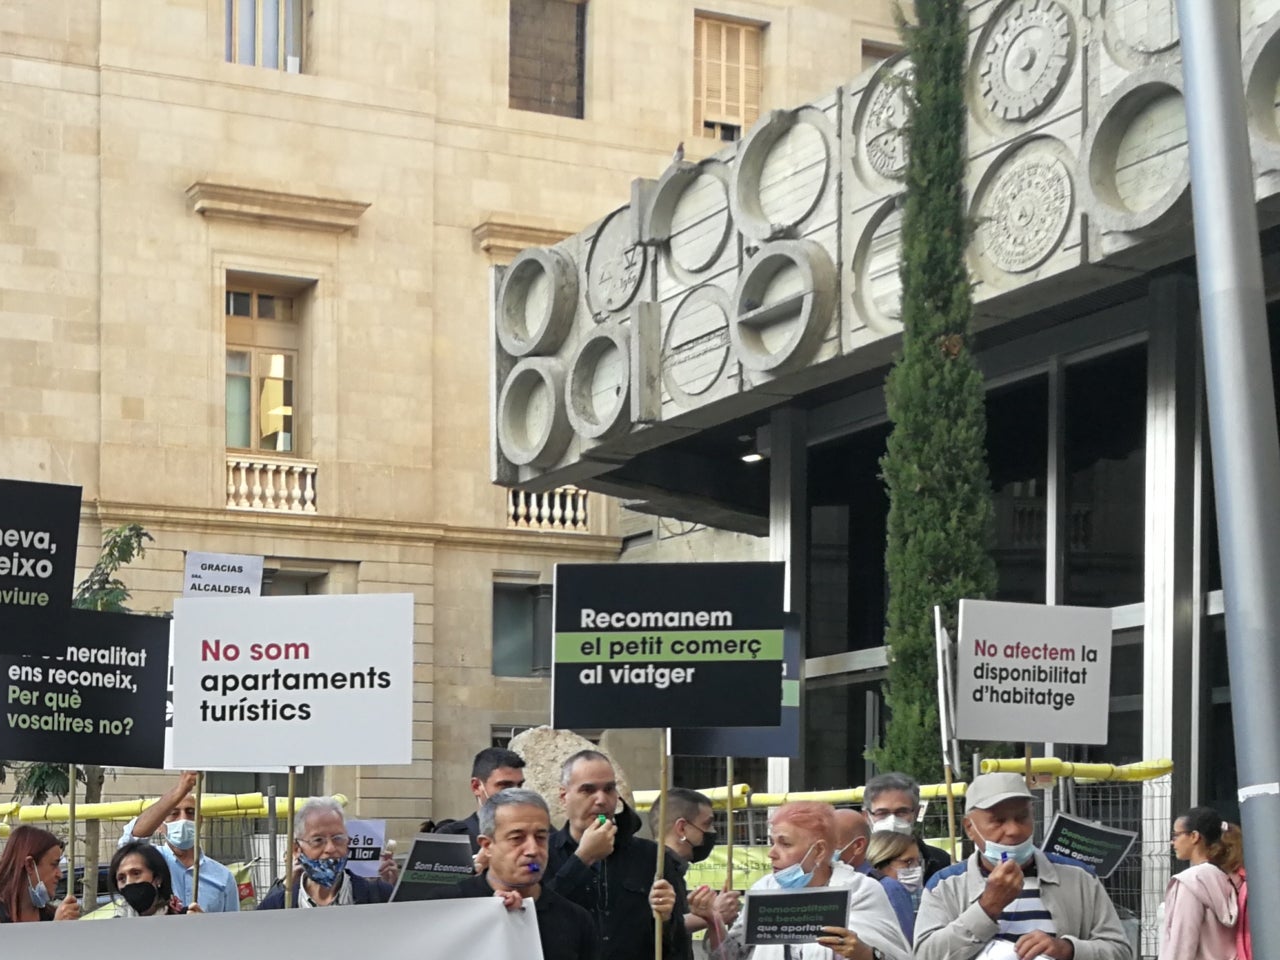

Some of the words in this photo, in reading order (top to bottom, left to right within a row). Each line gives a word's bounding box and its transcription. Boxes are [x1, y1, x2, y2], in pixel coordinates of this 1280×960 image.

[201, 563, 244, 573] GRACIAS
[190, 583, 251, 594] ALCALDESA
[580, 608, 732, 628] Recomanem
[42, 646, 147, 667] neralitat
[201, 639, 240, 661] No
[250, 642, 310, 661] som
[580, 637, 602, 656] el
[609, 636, 663, 659] petit
[670, 638, 762, 659] comerç
[974, 639, 998, 657] No
[1003, 641, 1075, 661] afectem
[1081, 645, 1097, 663] la
[8, 665, 42, 682] ens
[48, 668, 137, 693] reconeix,
[200, 666, 391, 696] apartaments
[579, 665, 602, 685] al
[610, 664, 695, 689] viatger
[973, 662, 1087, 684] disponibilitat
[8, 685, 39, 705] Per
[45, 688, 82, 710] què
[200, 696, 311, 722] turístics
[7, 712, 93, 733] vosaltres
[99, 717, 134, 735] no?
[363, 836, 373, 845] la
[1054, 844, 1070, 856] que
[781, 924, 822, 933] aporten
